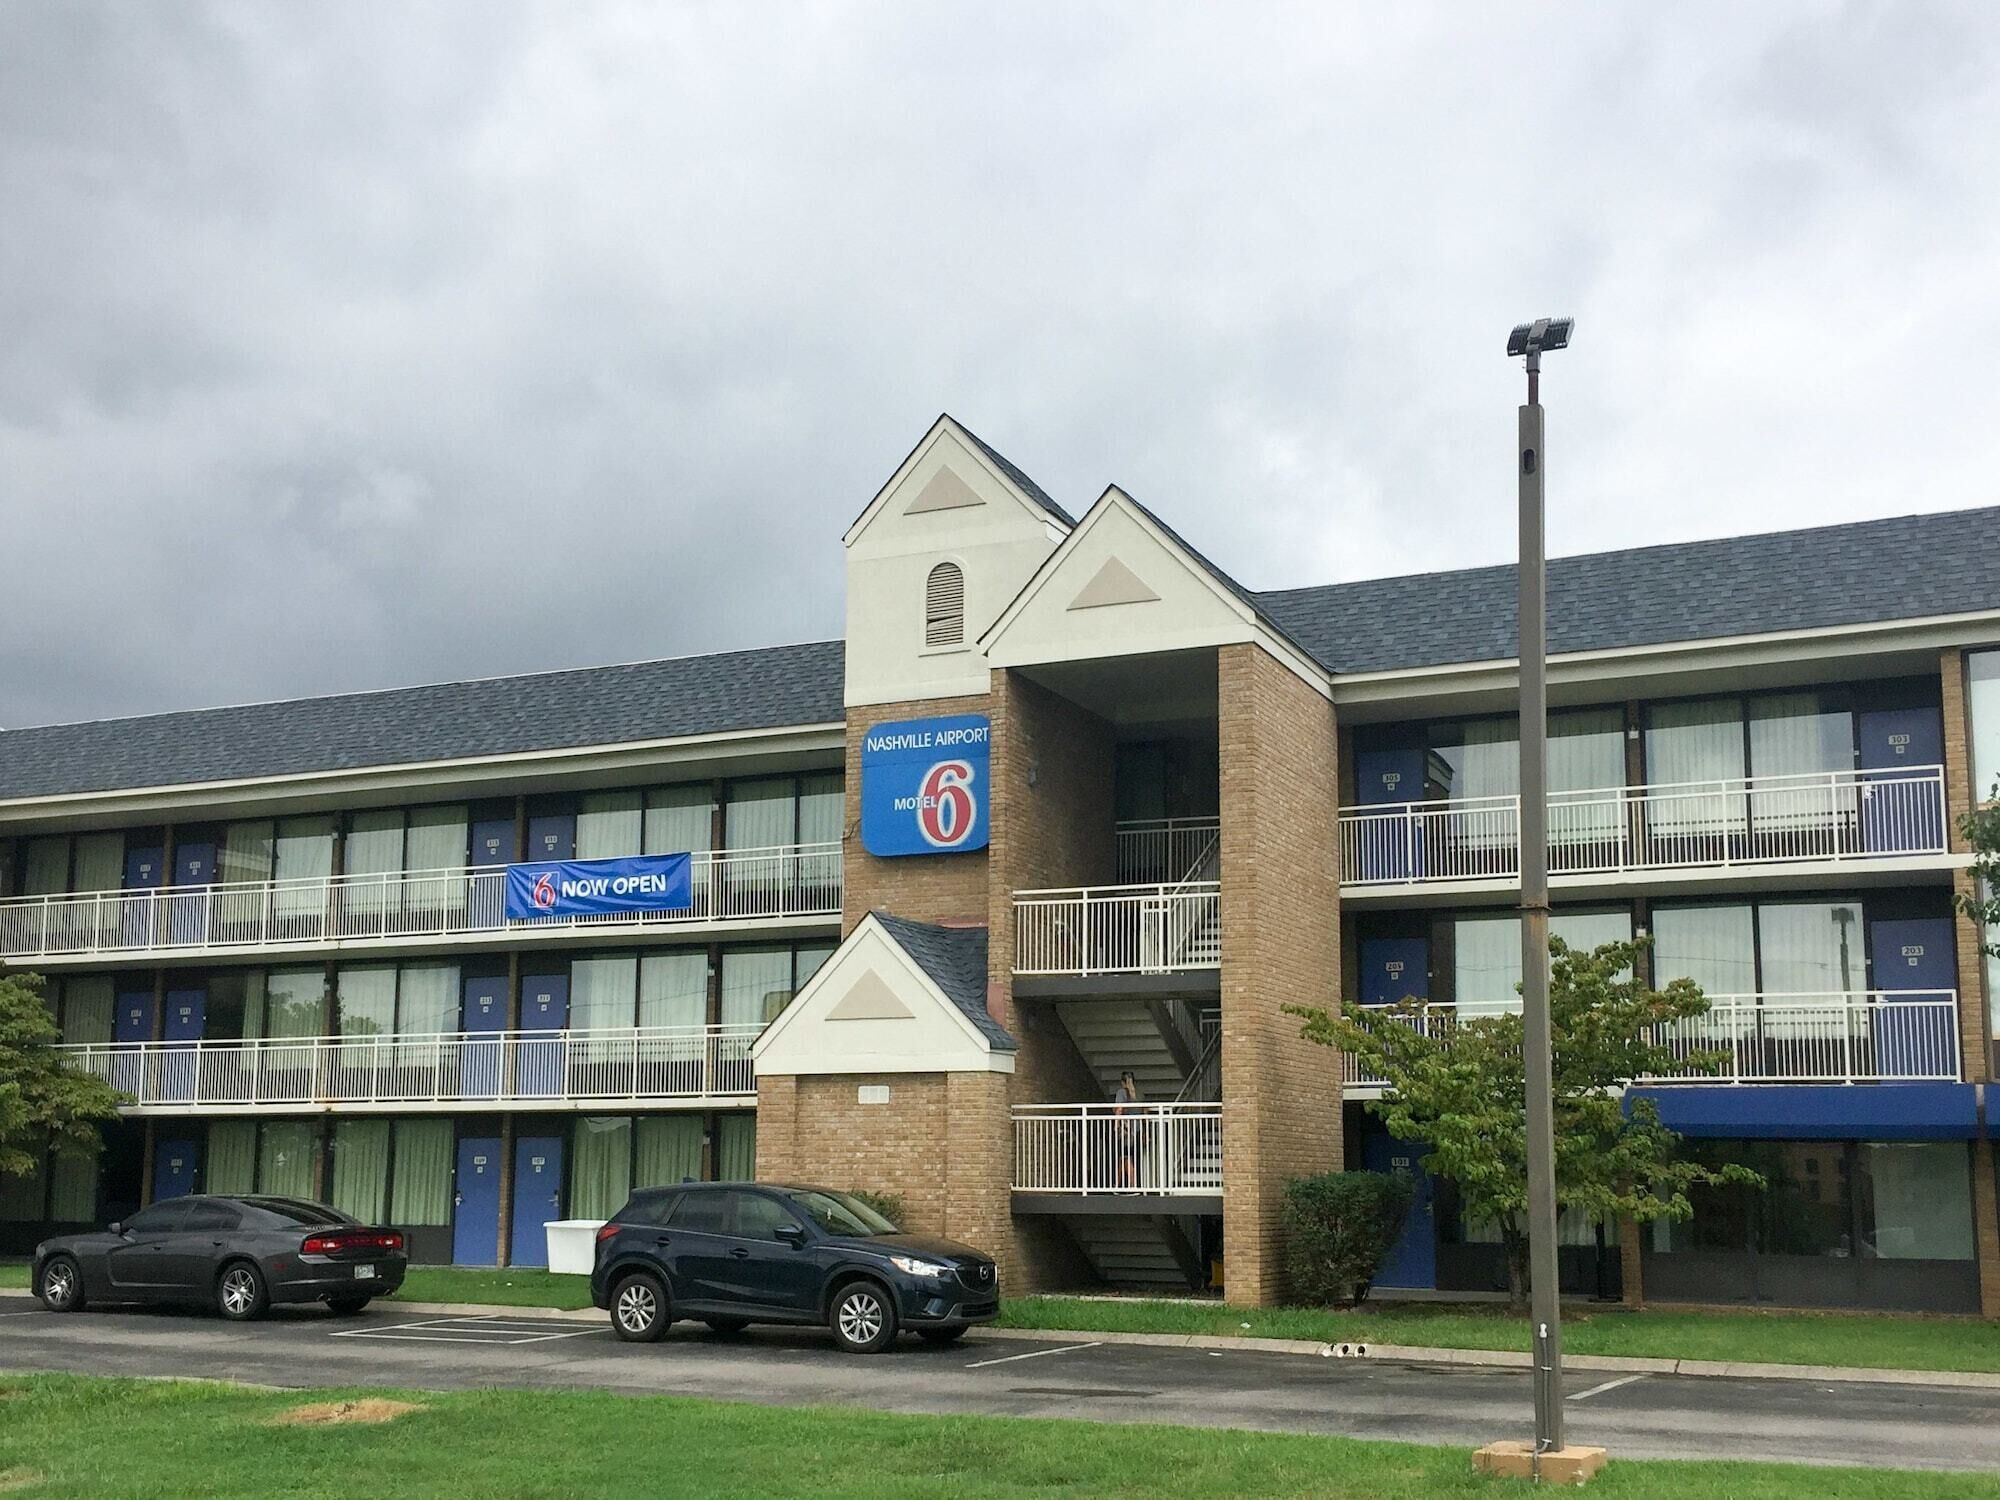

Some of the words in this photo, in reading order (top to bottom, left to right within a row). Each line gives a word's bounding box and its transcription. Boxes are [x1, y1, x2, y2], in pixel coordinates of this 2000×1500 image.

[867, 733, 932, 752] NASHVILLE
[934, 727, 989, 746] AIRPORT
[894, 795, 938, 811] MOTEL
[918, 759, 976, 847] 6
[533, 872, 556, 908] 6
[562, 879, 609, 897] NOW
[612, 874, 667, 894] OPEN
